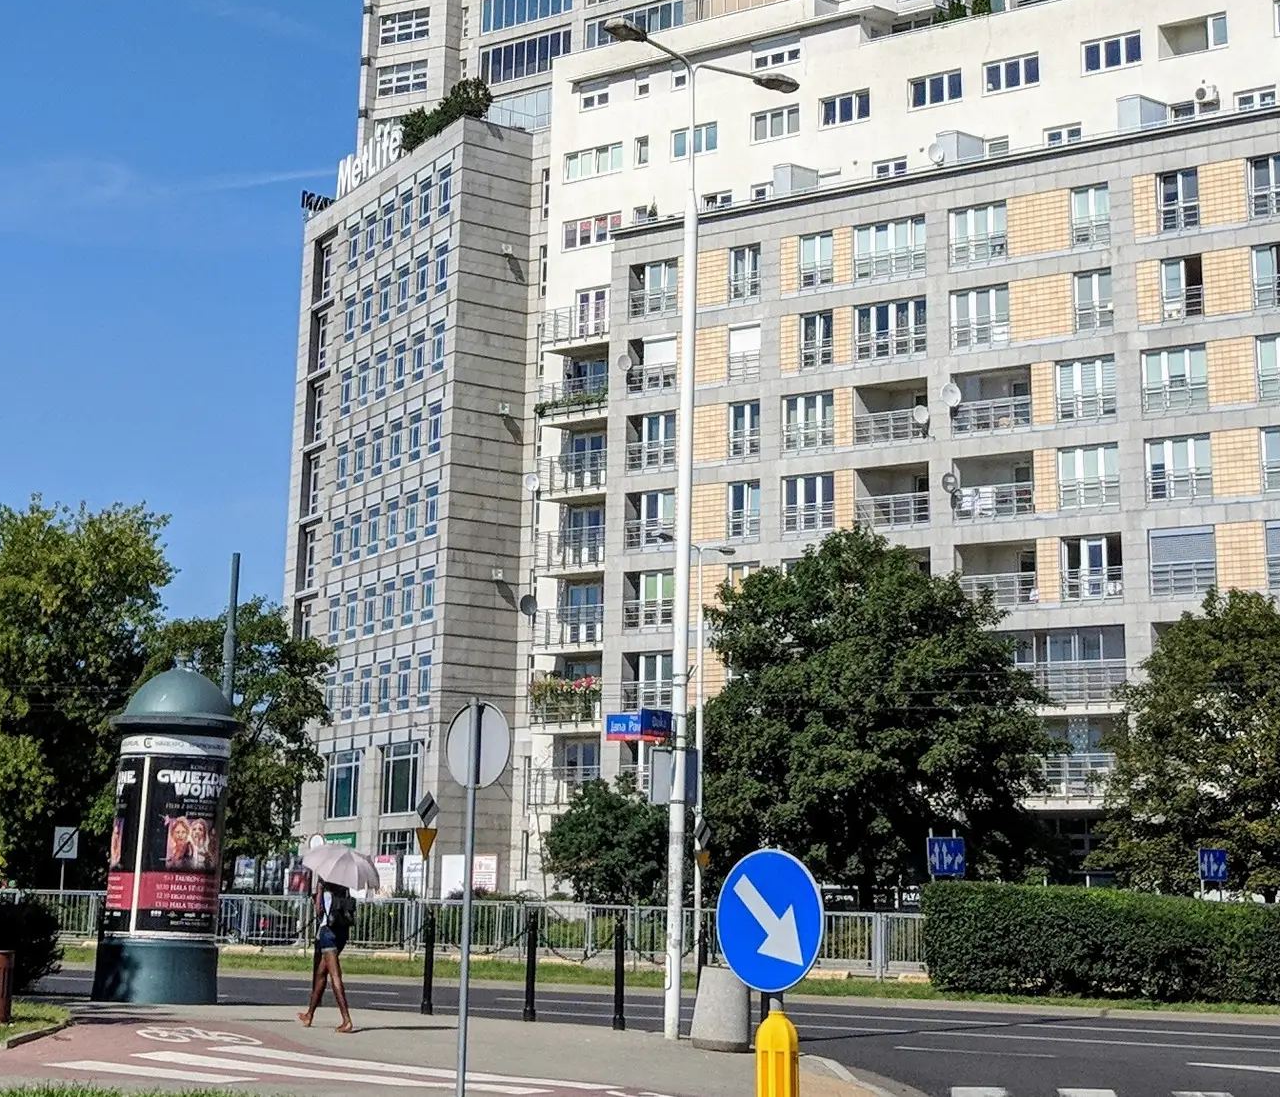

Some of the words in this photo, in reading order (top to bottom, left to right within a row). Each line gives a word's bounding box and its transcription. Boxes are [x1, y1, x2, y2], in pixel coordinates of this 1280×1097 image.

[336, 123, 403, 201] MetLife
[610, 721, 626, 732] Jana
[174, 783, 223, 799] WOJNY
